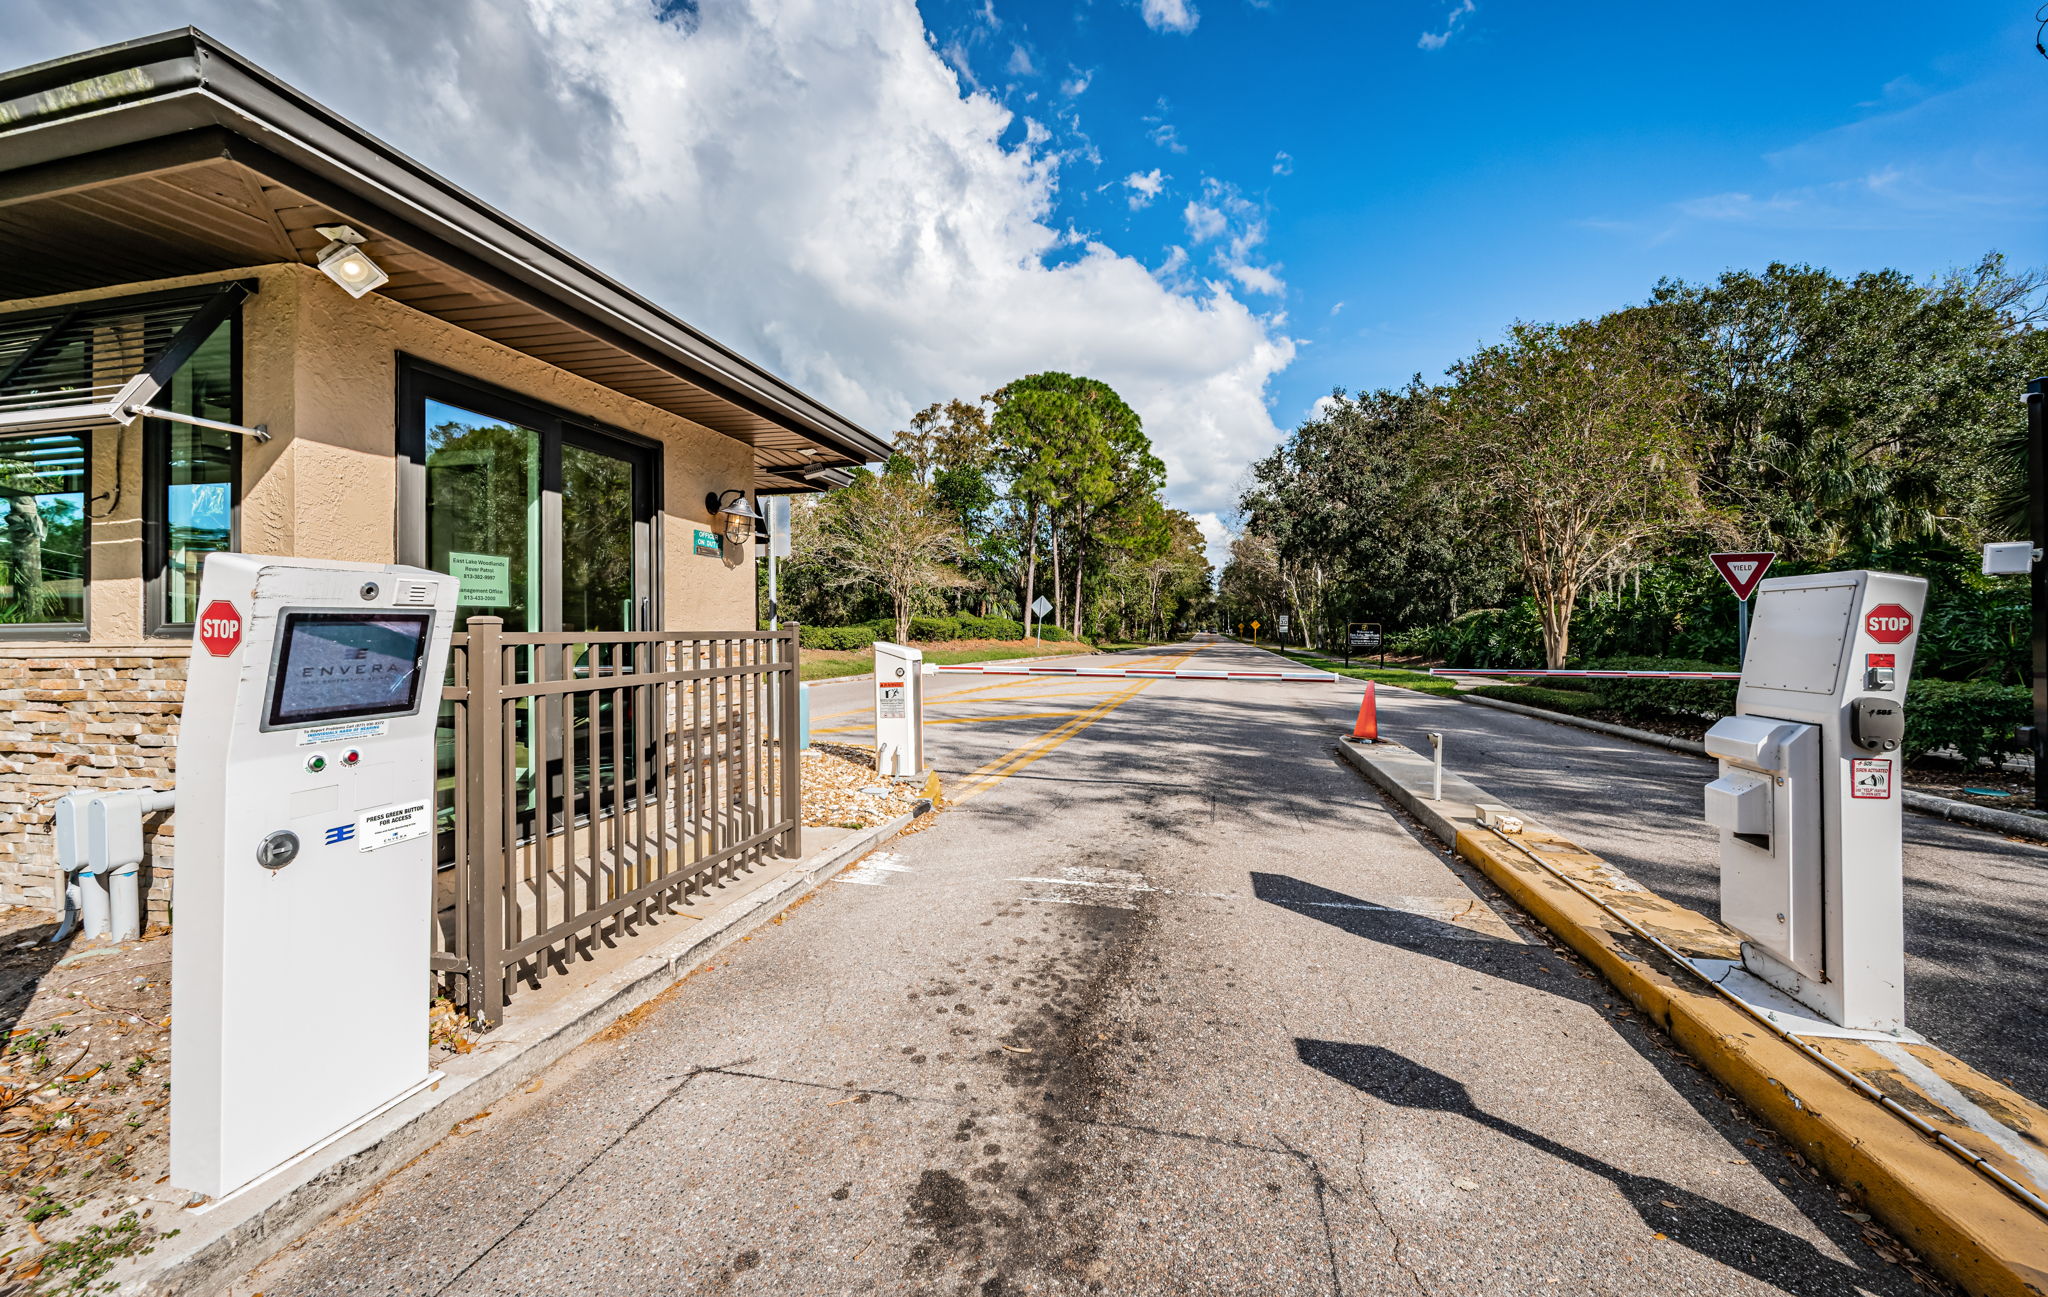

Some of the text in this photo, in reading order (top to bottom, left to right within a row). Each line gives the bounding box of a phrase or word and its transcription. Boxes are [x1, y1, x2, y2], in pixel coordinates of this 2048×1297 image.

[203, 618, 238, 638] STOP
[1869, 617, 1910, 631] STOP
[302, 664, 398, 677] ENVERA
[366, 805, 424, 822] PRESS GREEN BUTTON
[392, 814, 412, 823] ACCESS
[384, 834, 407, 842] ENVERA
